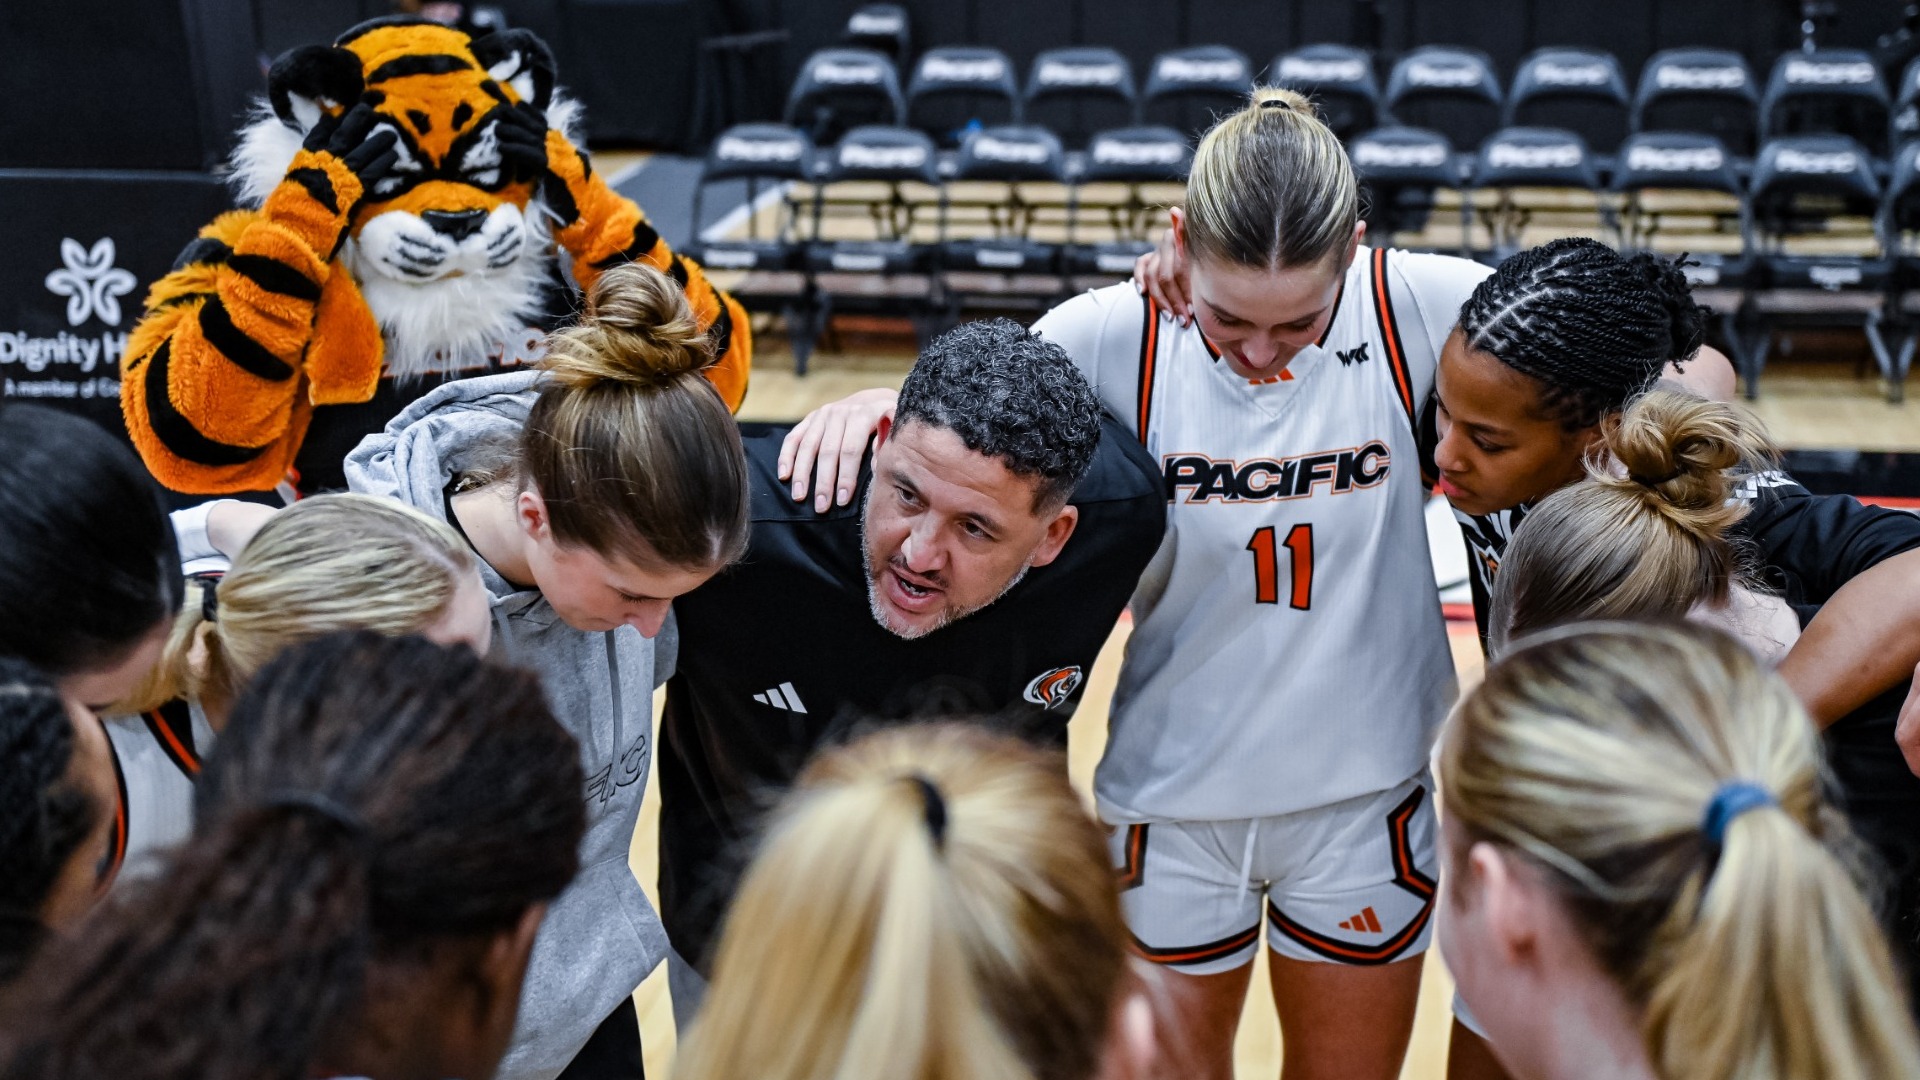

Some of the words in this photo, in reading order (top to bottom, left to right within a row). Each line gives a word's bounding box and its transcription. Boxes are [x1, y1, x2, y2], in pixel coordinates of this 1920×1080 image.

[0, 331, 100, 372] Dignity
[1162, 440, 1391, 504] PACIFIC
[1246, 523, 1314, 611] 11
